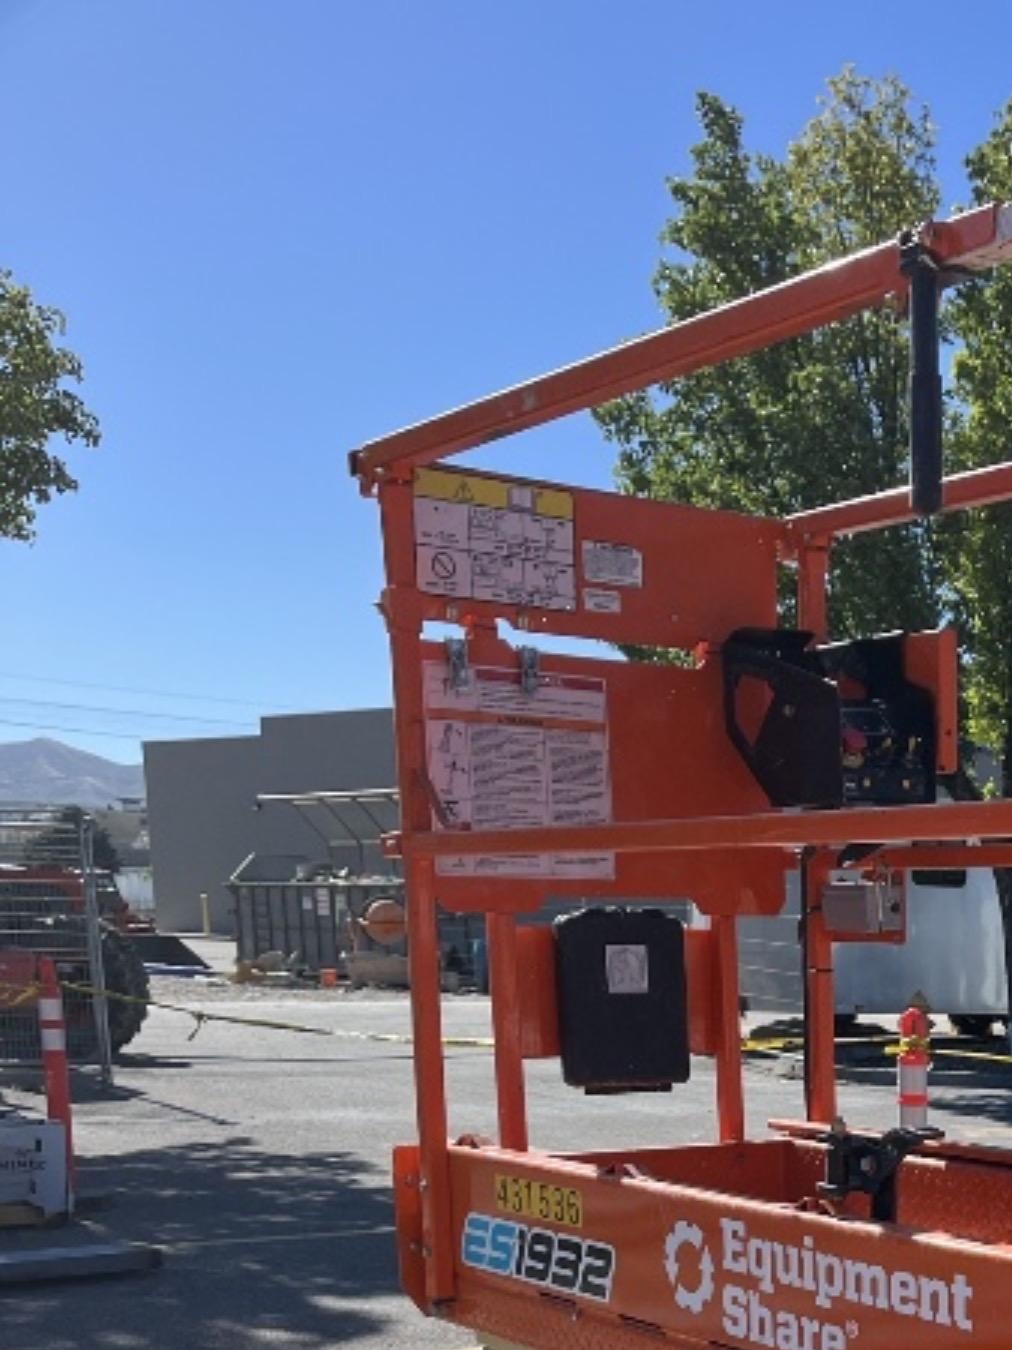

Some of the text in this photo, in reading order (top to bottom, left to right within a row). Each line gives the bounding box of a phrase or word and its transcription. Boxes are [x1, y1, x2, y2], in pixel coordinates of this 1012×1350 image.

[496, 1177, 581, 1226] 431536
[462, 1211, 616, 1304] ES1932
[719, 1218, 973, 1332] Equipment
